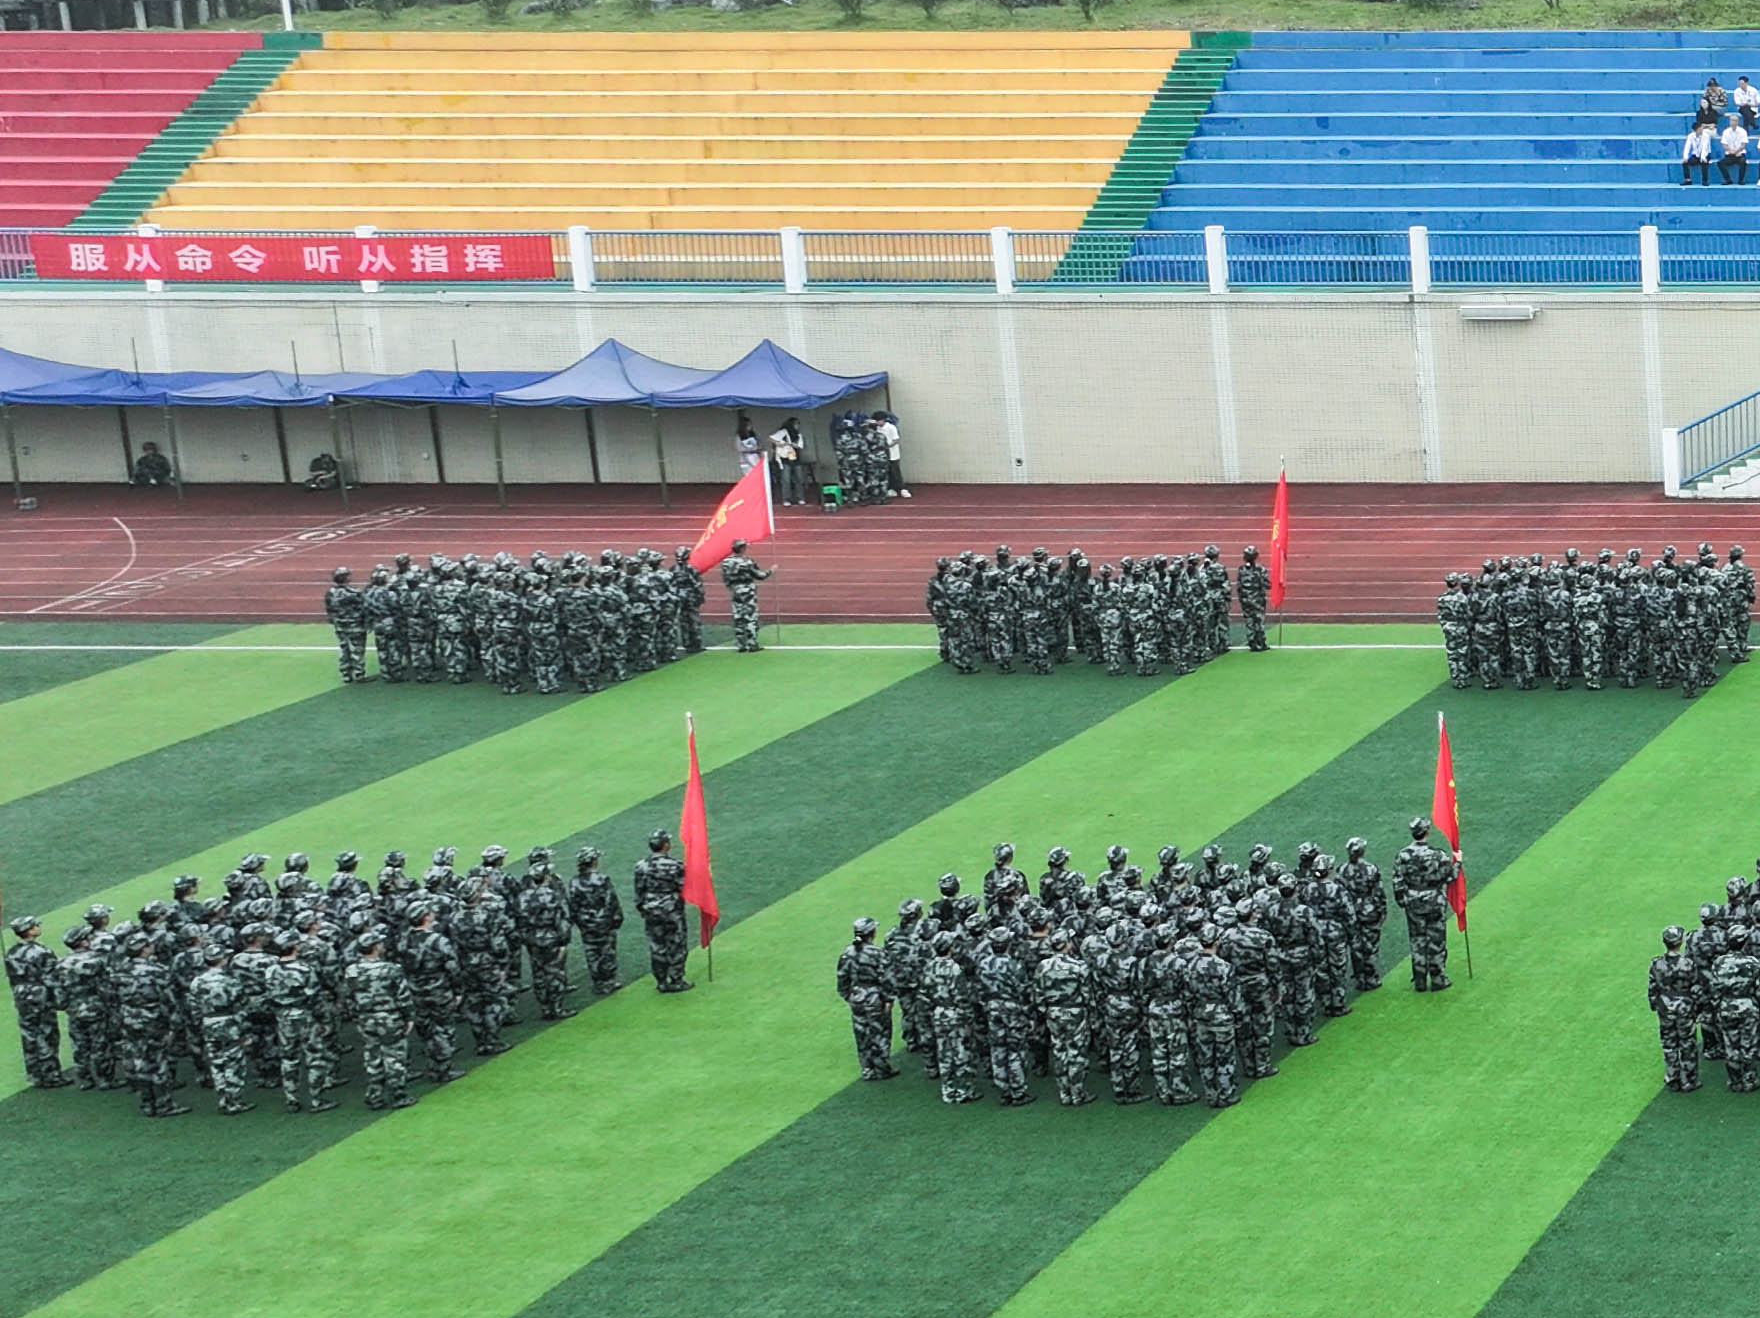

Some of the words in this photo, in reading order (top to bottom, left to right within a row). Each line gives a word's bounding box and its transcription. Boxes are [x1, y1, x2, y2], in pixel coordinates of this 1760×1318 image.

[68, 243, 268, 273] 服从命令
[302, 243, 504, 274] 听从指挥
